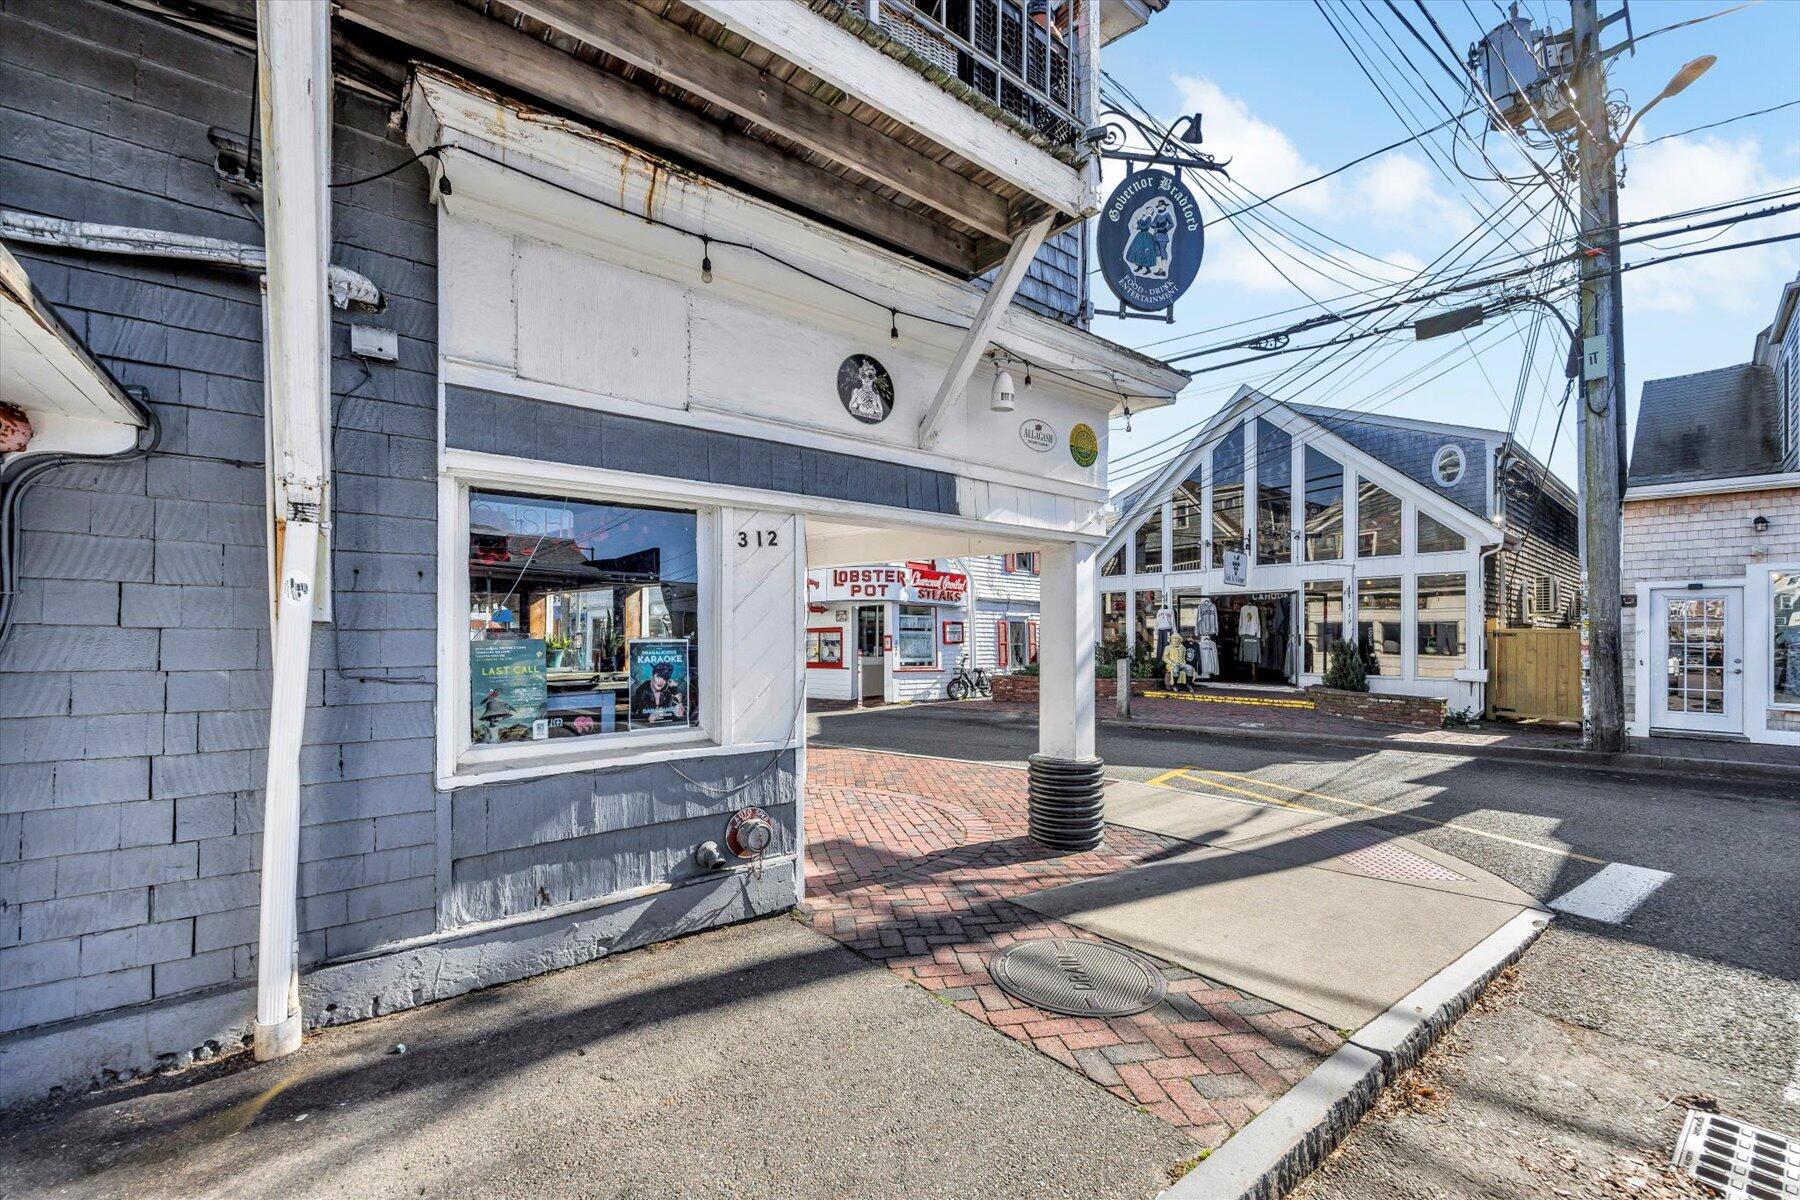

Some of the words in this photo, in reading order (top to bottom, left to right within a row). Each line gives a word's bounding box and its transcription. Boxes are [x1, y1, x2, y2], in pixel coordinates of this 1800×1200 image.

[1108, 176, 1154, 224] Governor
[1158, 175, 1198, 232] Bradford
[1118, 278, 1180, 303] ENTERTAINMENT
[1123, 274, 1144, 295] FOOD
[1149, 279, 1175, 296] DRINK
[738, 530, 778, 548] 312
[833, 568, 908, 588] LOBSTER
[850, 583, 889, 597] POT
[917, 588, 962, 602] STEAKS
[637, 655, 683, 664] KARAOKE
[482, 666, 510, 676] LAST
[513, 665, 540, 674] CALL
[734, 809, 753, 826] AUTO
